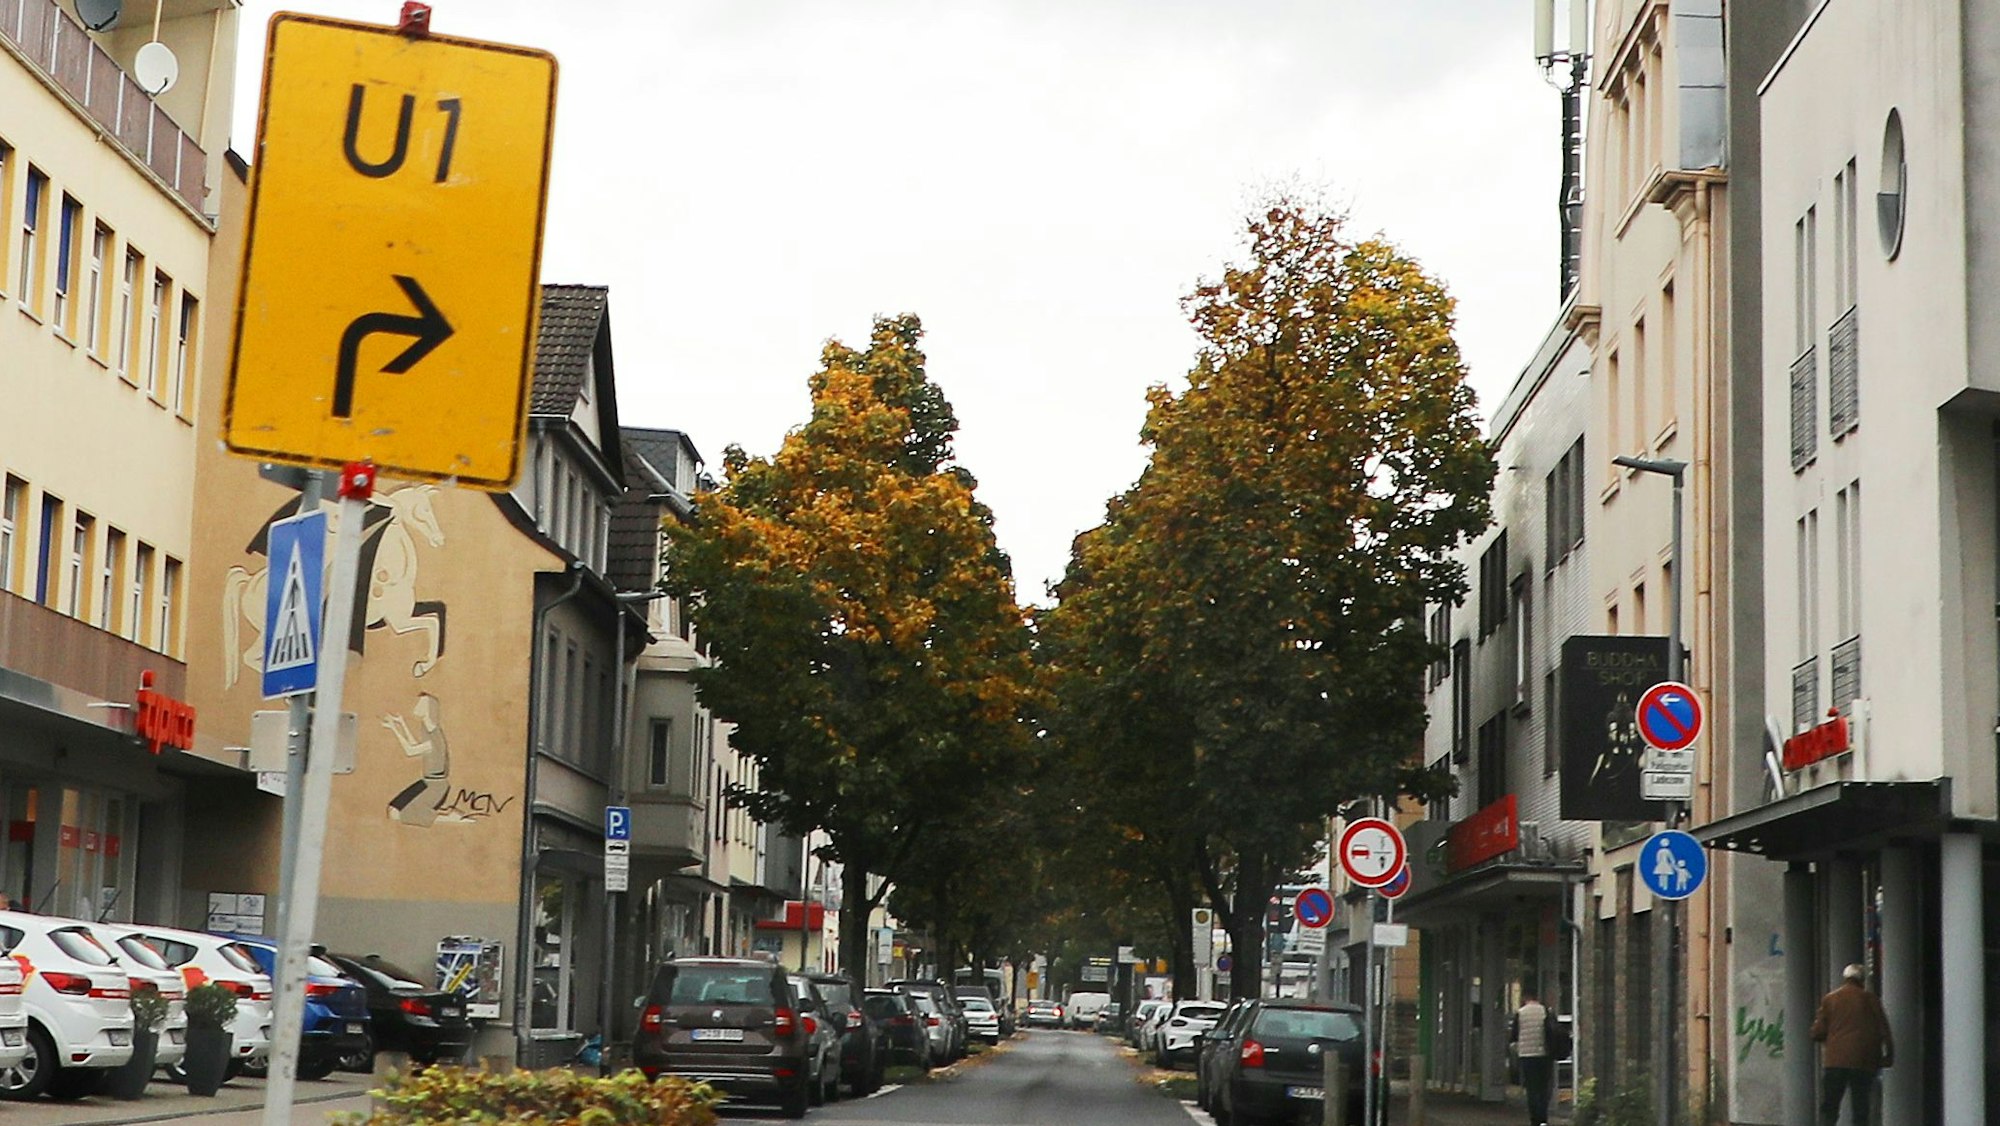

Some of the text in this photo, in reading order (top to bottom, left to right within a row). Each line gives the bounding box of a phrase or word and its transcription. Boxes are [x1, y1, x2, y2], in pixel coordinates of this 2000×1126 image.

[343, 83, 461, 183] U1
[1587, 651, 1658, 667] BUDDHA
[609, 811, 624, 836] P
